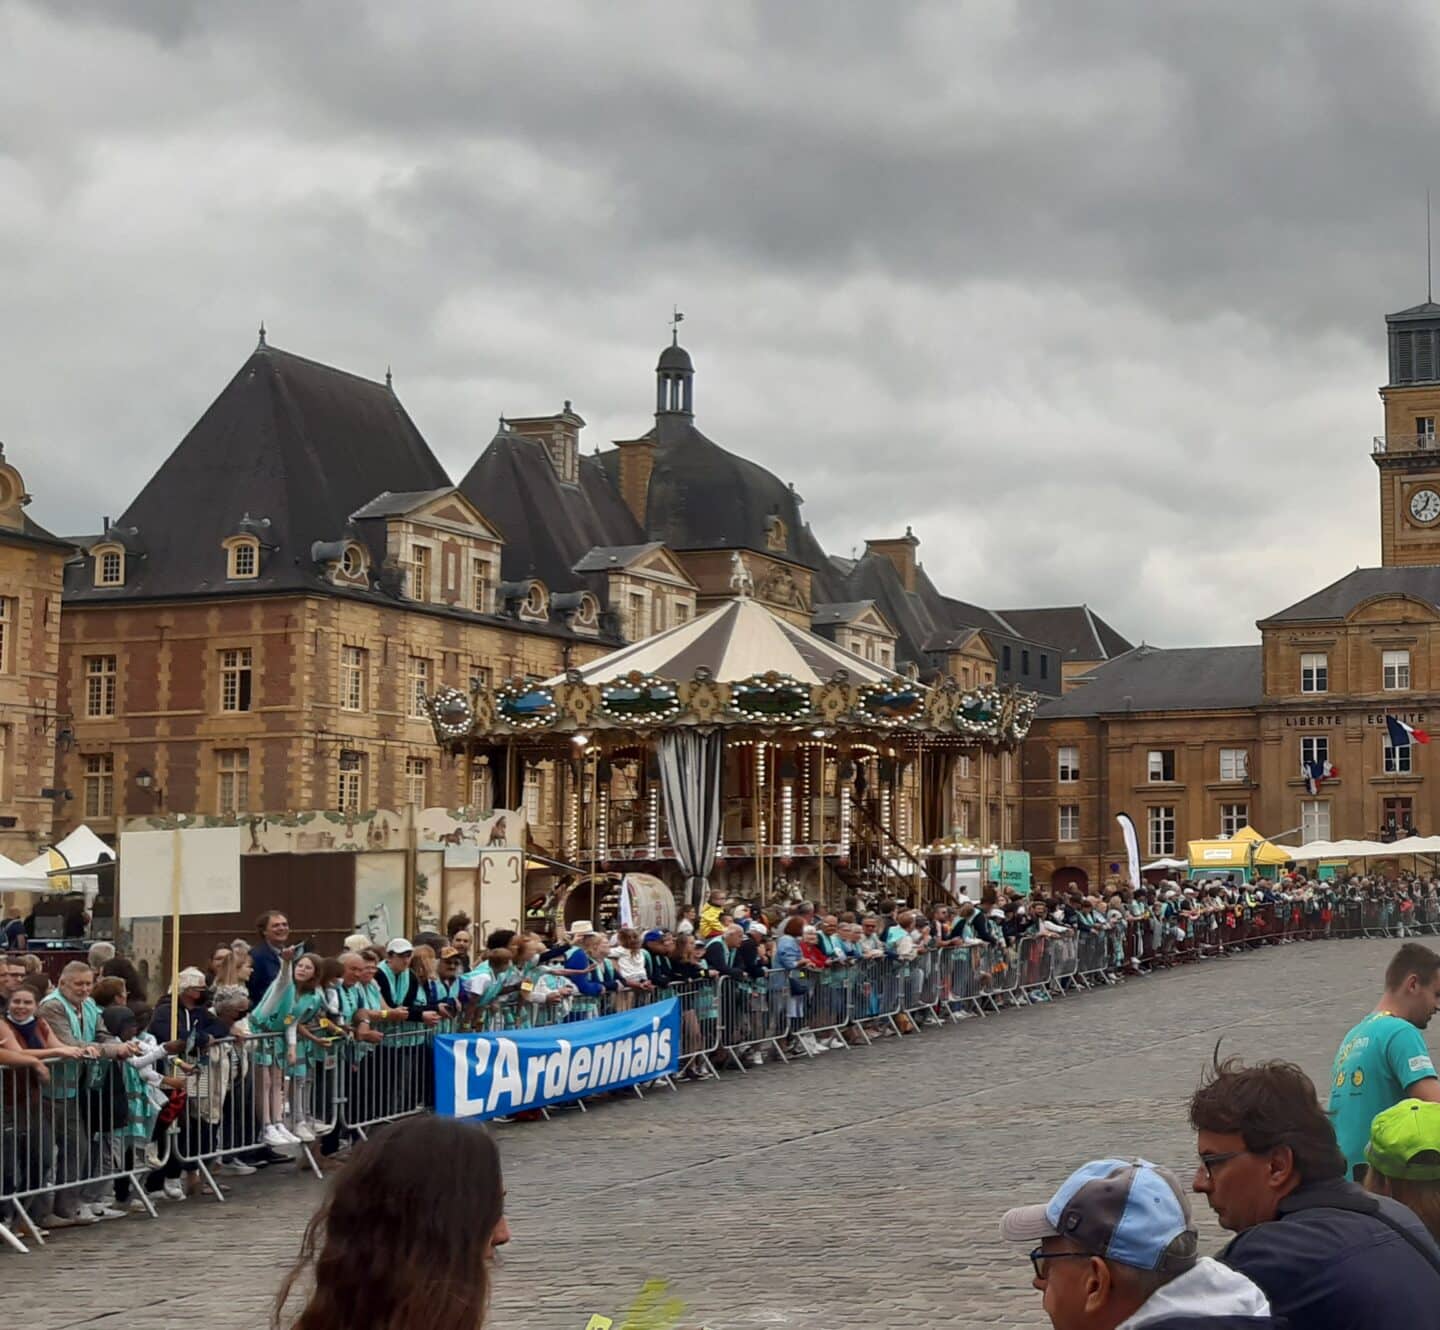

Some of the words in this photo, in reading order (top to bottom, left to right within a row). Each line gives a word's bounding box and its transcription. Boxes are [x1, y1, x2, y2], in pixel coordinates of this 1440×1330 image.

[1286, 715, 1342, 726] LIBERTE
[1367, 713, 1425, 725] EGITE
[453, 1017, 671, 1118] L'Ardennais
